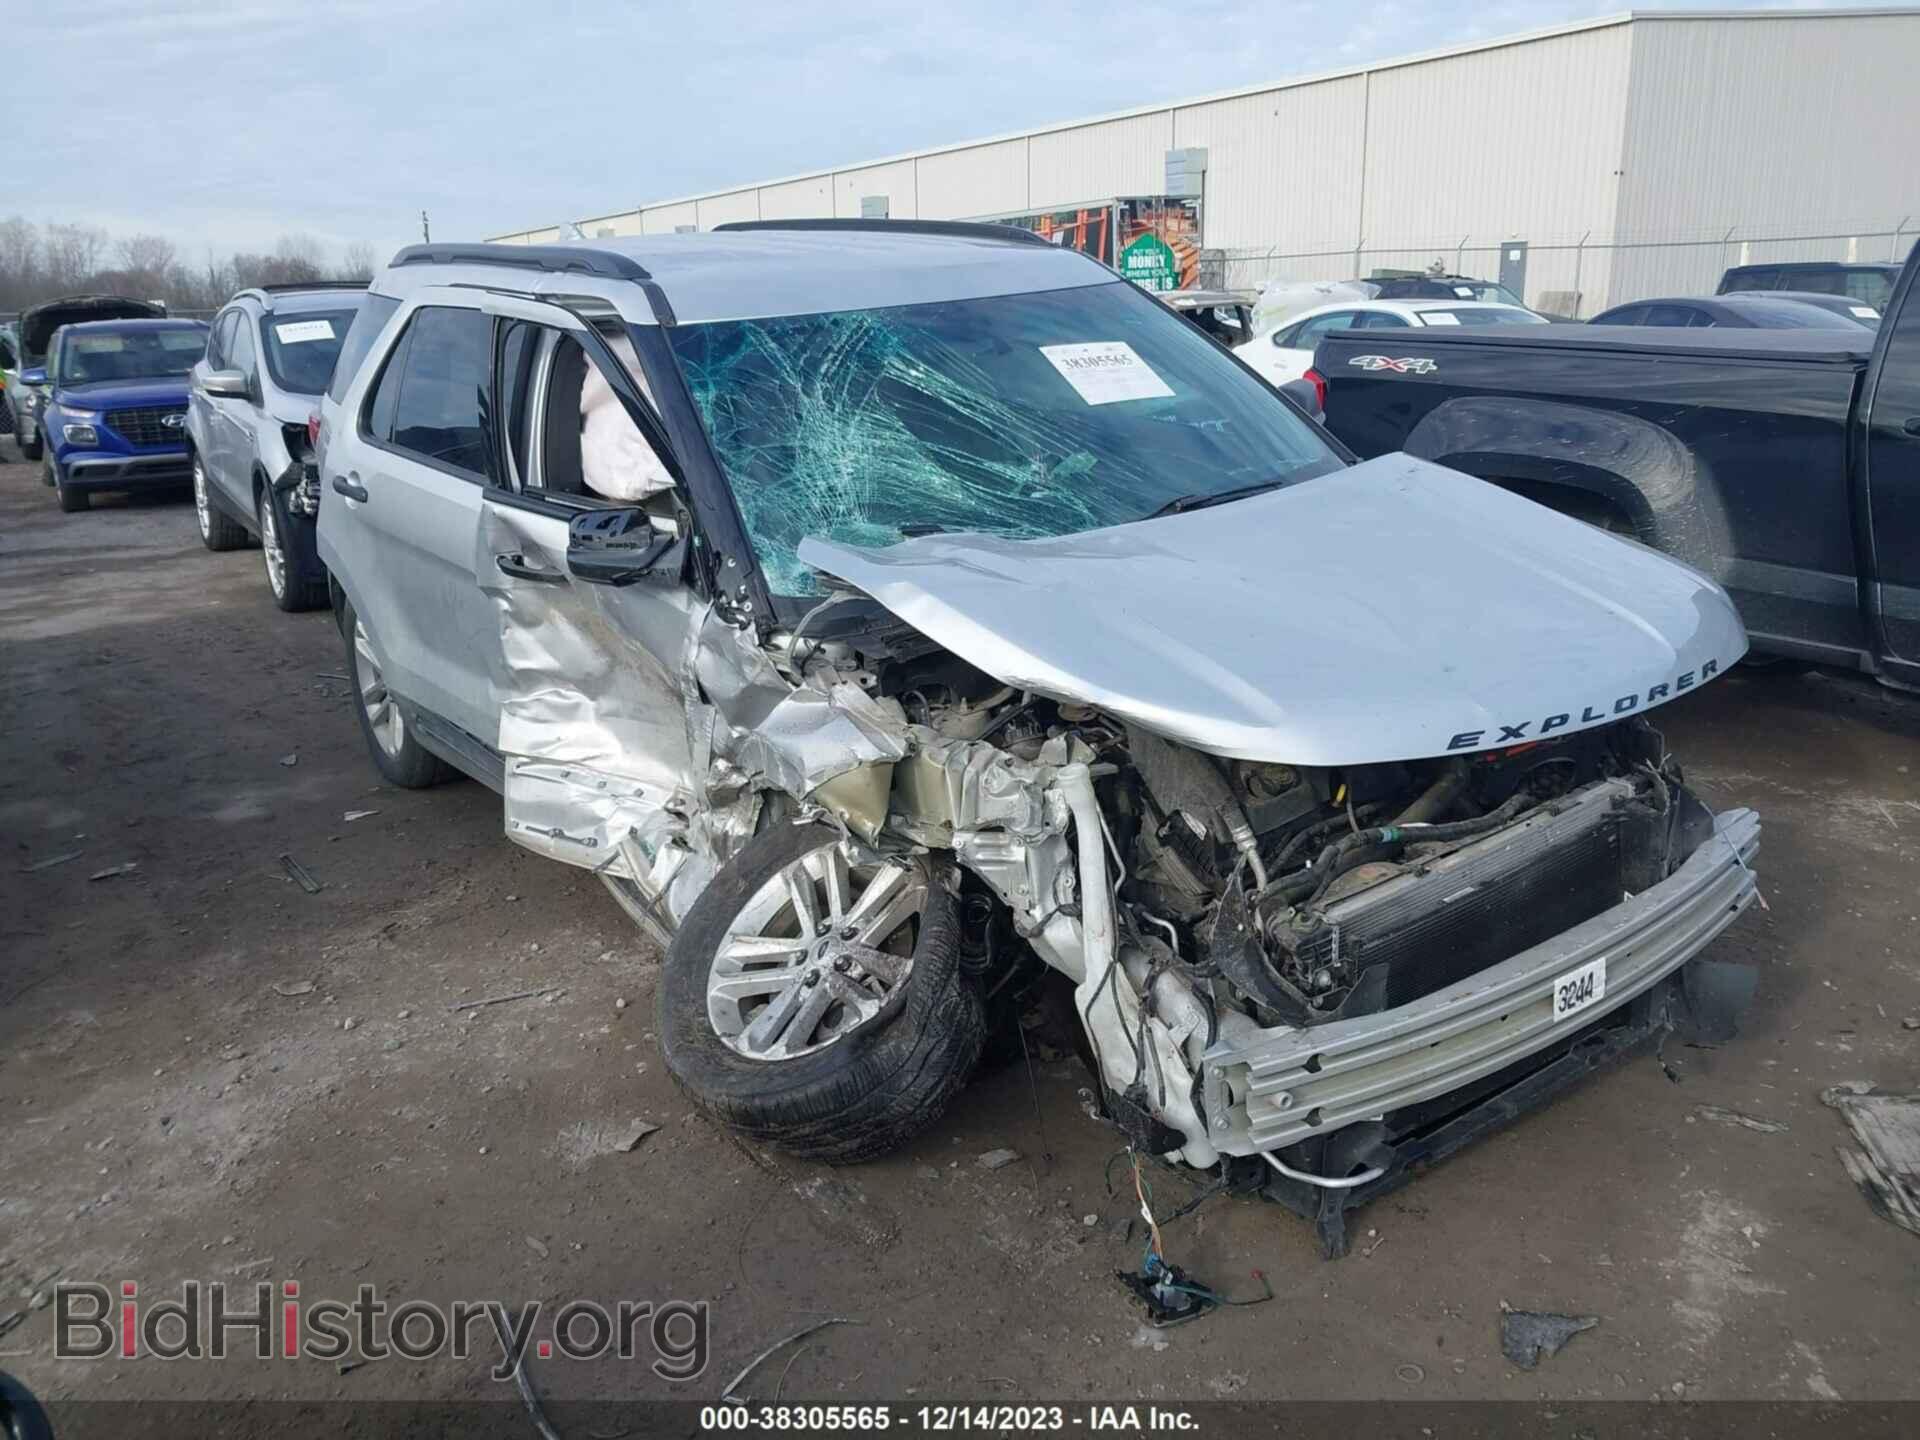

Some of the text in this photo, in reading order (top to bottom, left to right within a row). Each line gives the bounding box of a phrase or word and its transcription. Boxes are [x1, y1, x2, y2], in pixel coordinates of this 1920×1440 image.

[1128, 254, 1165, 269] MONEY
[1126, 270, 1150, 278] WHERE
[1162, 277, 1174, 290] IS
[1061, 353, 1134, 371] 38305565
[1446, 658, 1720, 751] EXPLORER
[1558, 971, 1594, 1013] 3244
